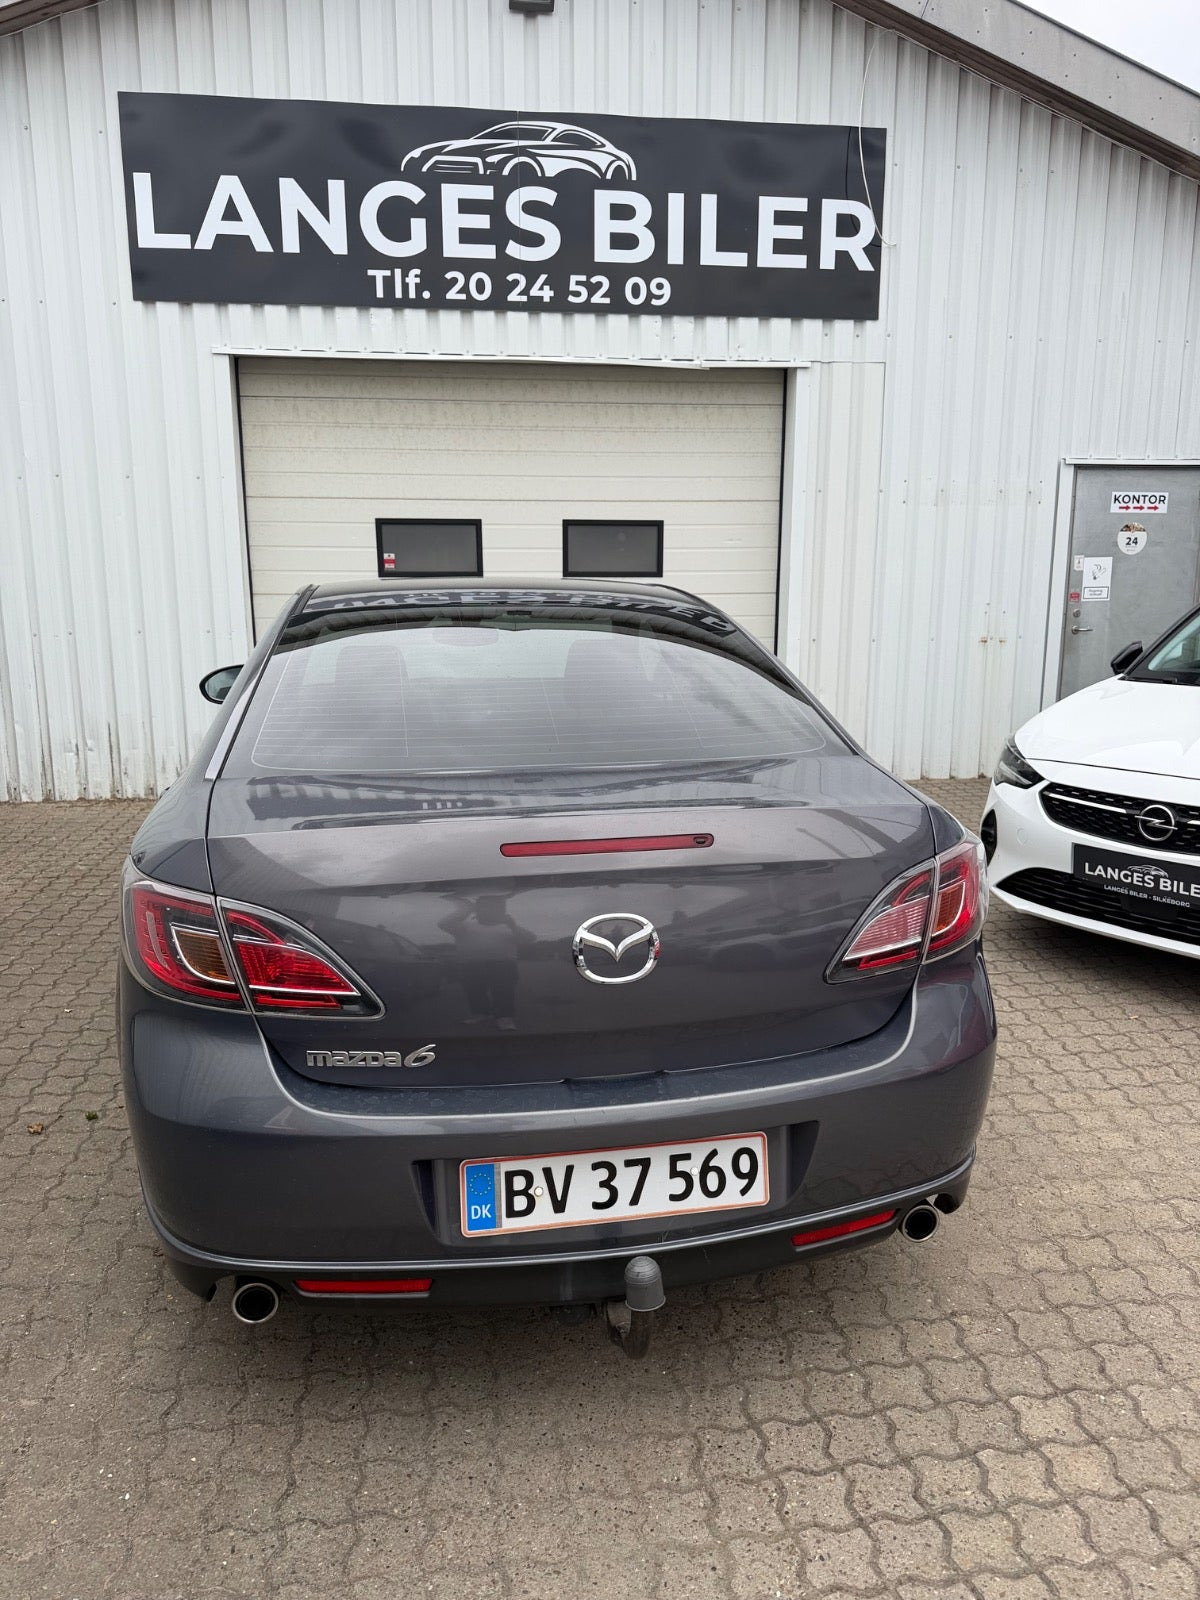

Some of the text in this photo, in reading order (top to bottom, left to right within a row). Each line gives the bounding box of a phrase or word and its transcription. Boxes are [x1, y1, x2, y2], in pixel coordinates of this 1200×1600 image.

[133, 172, 879, 272] LANGES BILER
[367, 268, 672, 306] Tlf. 20 24 52 09
[1113, 494, 1167, 505] KONTOR
[1125, 536, 1138, 546] 24
[1084, 862, 1155, 888] LANGES
[1103, 884, 1129, 895] LANGES
[1129, 889, 1148, 899] BILER
[1152, 895, 1191, 908] SILKEBORG
[504, 1146, 759, 1219] BV 37 569
[471, 1203, 492, 1220] DK
